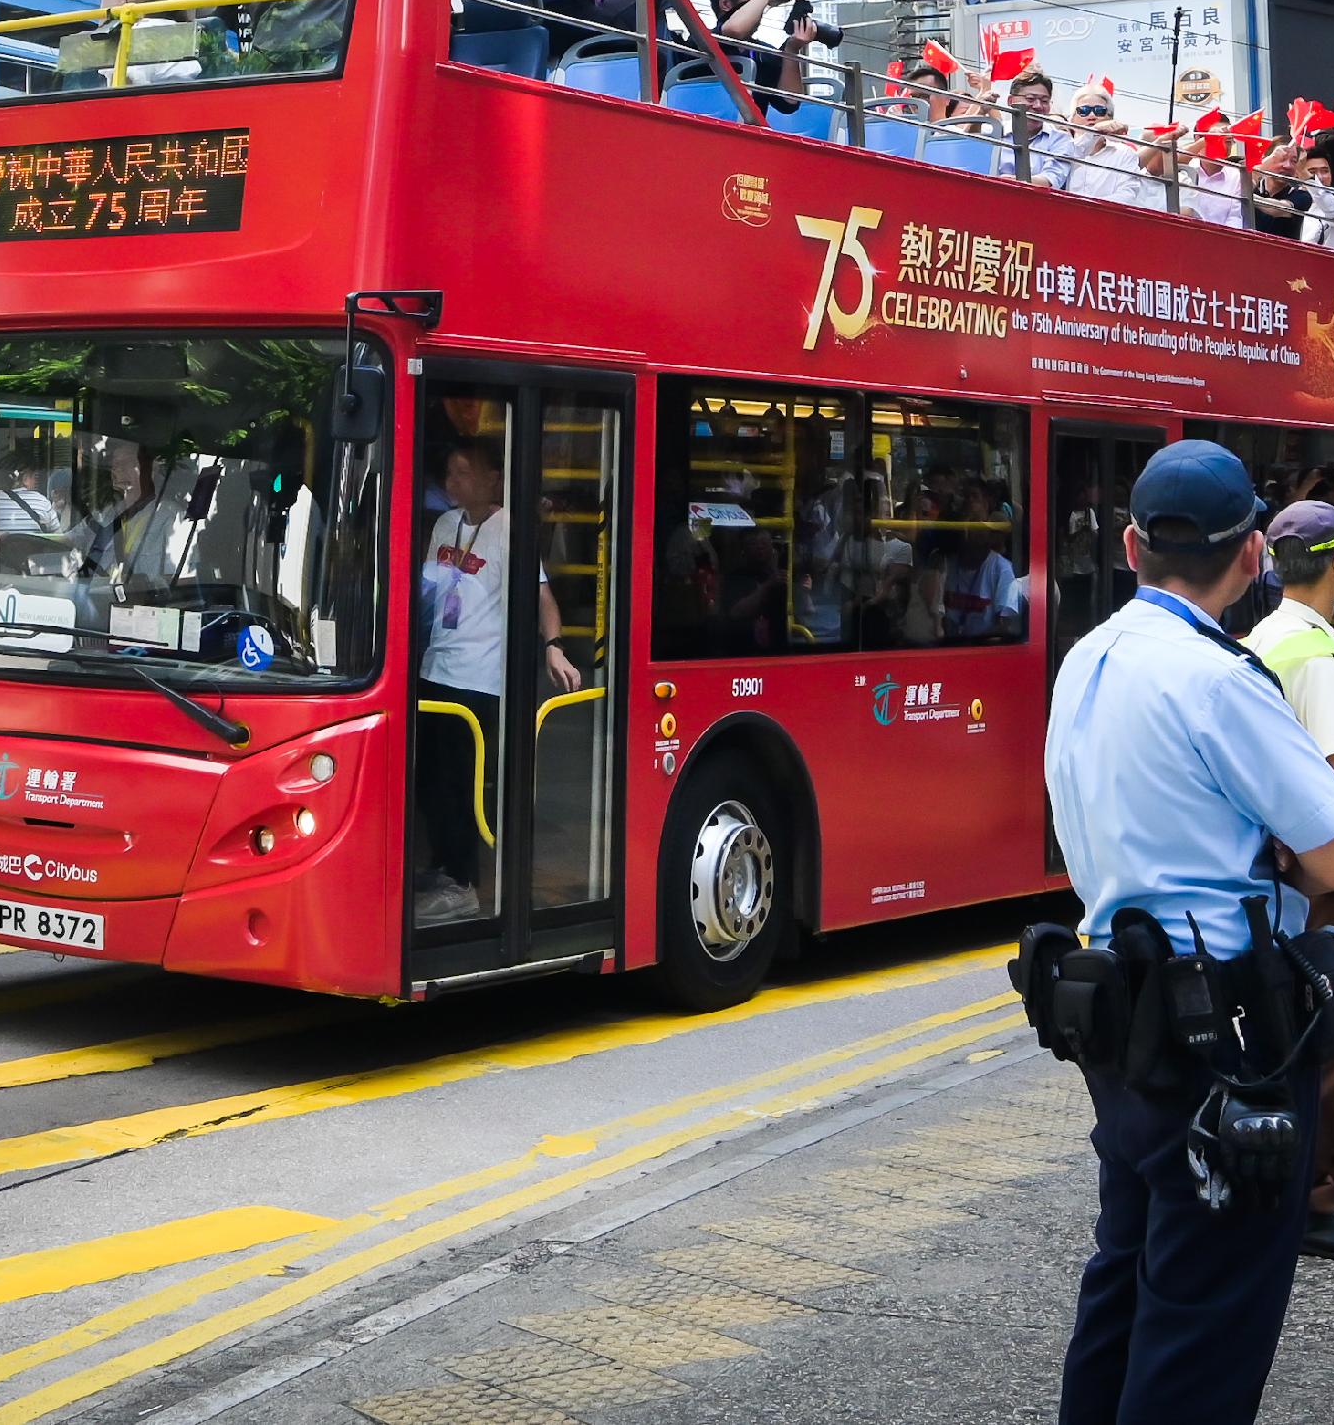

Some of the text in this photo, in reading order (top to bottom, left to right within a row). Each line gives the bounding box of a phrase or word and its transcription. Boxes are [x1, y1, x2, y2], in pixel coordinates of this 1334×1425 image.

[795, 205, 883, 351] 75
[898, 221, 1034, 301] 熱烈慶祝
[1035, 260, 1290, 337] 中華人民共和國成立七十五周年
[881, 291, 1301, 367] CELEBRATING the 75th Anniversary of the Founding of the People's Republic of China
[732, 677, 763, 698] 50901
[904, 682, 942, 706] 運輸署
[903, 707, 961, 723] Transport Department
[26, 768, 77, 792] 運輸署
[24, 790, 104, 809] Transport Department
[44, 860, 98, 884] Citybus
[0, 902, 96, 945] PR 8372
